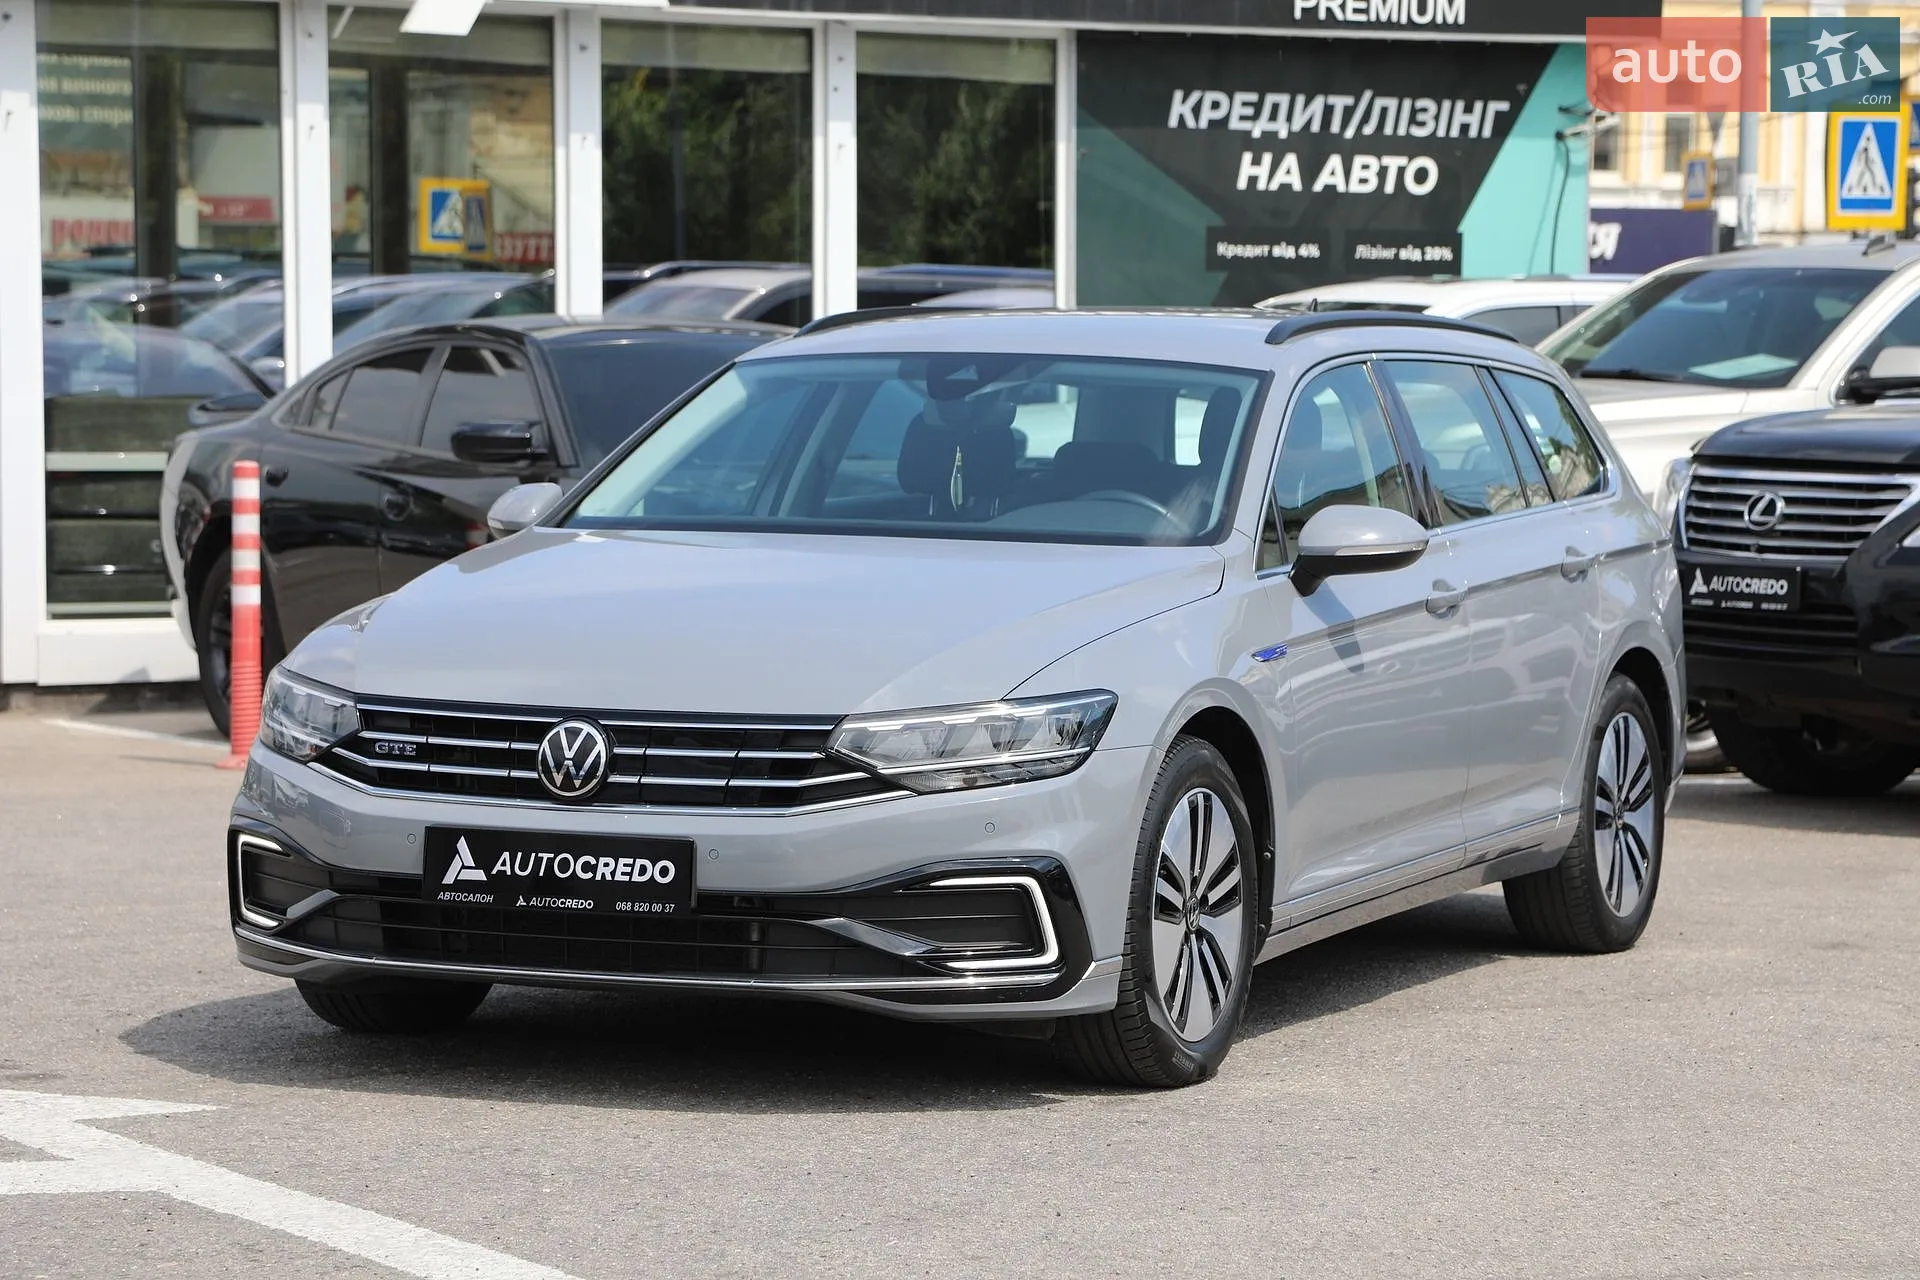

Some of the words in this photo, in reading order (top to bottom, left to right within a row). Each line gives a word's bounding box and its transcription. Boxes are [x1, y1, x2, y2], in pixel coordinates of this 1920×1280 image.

[1293, 0, 1466, 25] PREMIUM
[1167, 89, 1511, 139] КРЕДИТ/ЛІЗІНГ
[1236, 150, 1303, 192] НА
[1311, 153, 1439, 196] АВТО
[1215, 241, 1270, 260] Кредит
[1272, 241, 1297, 259] від
[1298, 242, 1321, 258] 4%
[1354, 243, 1399, 260] Лізінг
[1399, 244, 1423, 262] від
[1709, 575, 1788, 596] AUTOCREDO
[374, 740, 417, 756] GTE
[490, 851, 676, 884] AUTOCREDO
[437, 891, 494, 904] АВТОСАЛОН
[529, 896, 594, 909] AUTOCREDO
[615, 901, 632, 911] 068
[634, 902, 650, 912] 820
[651, 903, 664, 912] 00
[665, 903, 676, 913] 37
